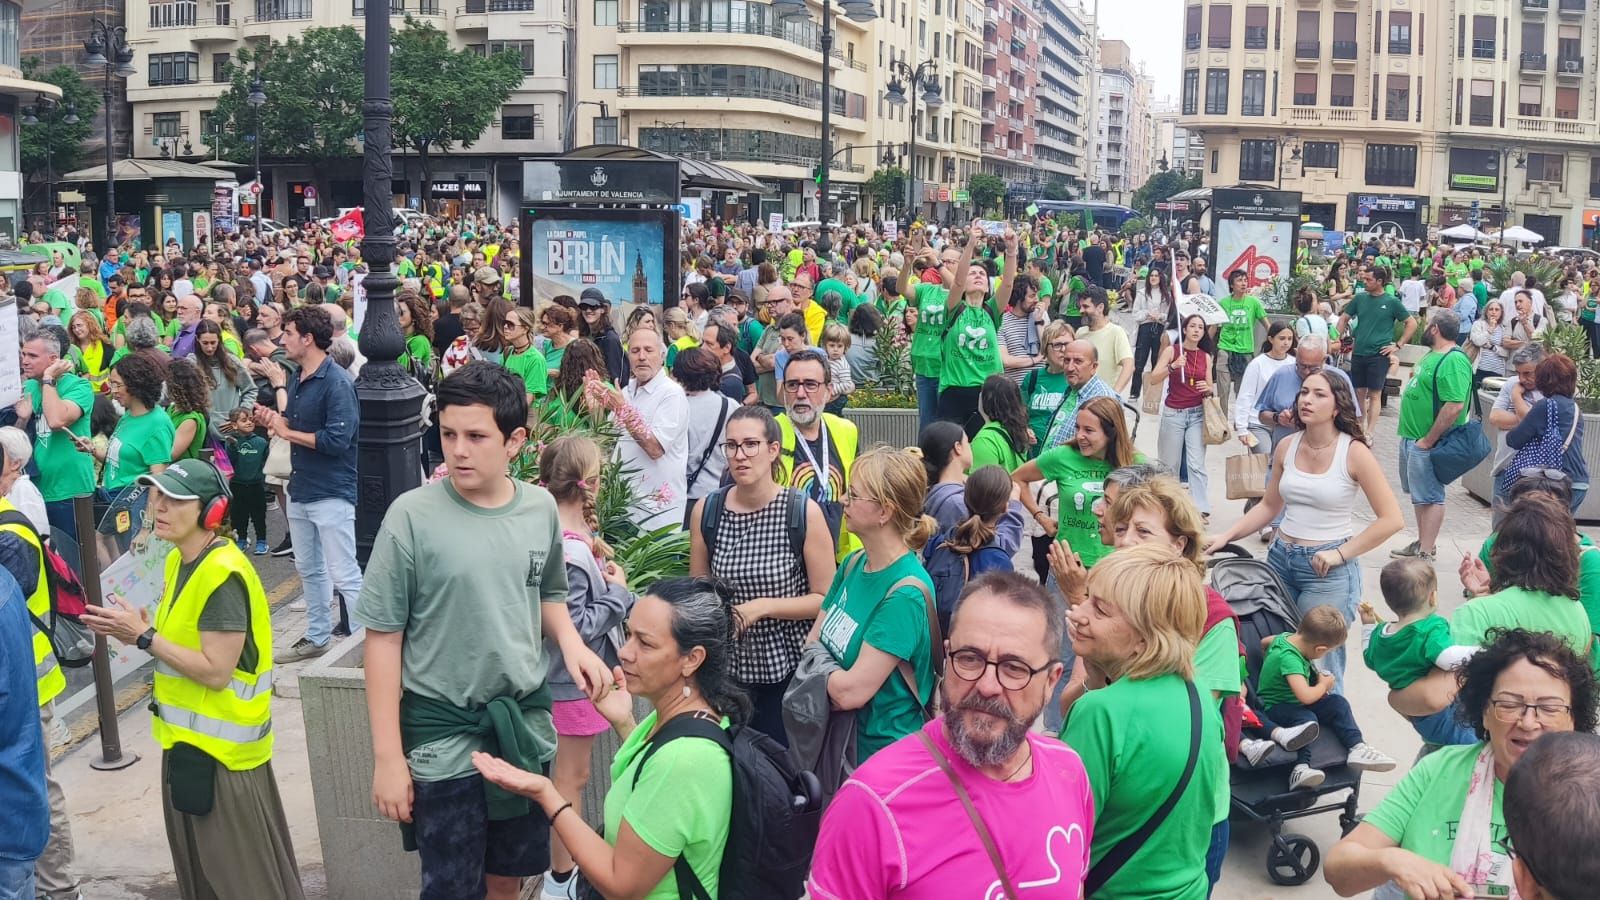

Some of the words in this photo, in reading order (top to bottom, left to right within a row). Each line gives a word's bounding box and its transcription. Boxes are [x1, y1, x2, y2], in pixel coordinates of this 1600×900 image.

[555, 190, 599, 198] AJUNTAMENT
[600, 190, 609, 198] DE
[610, 191, 643, 199] VALENCIA
[548, 234, 625, 275] BERLÍN
